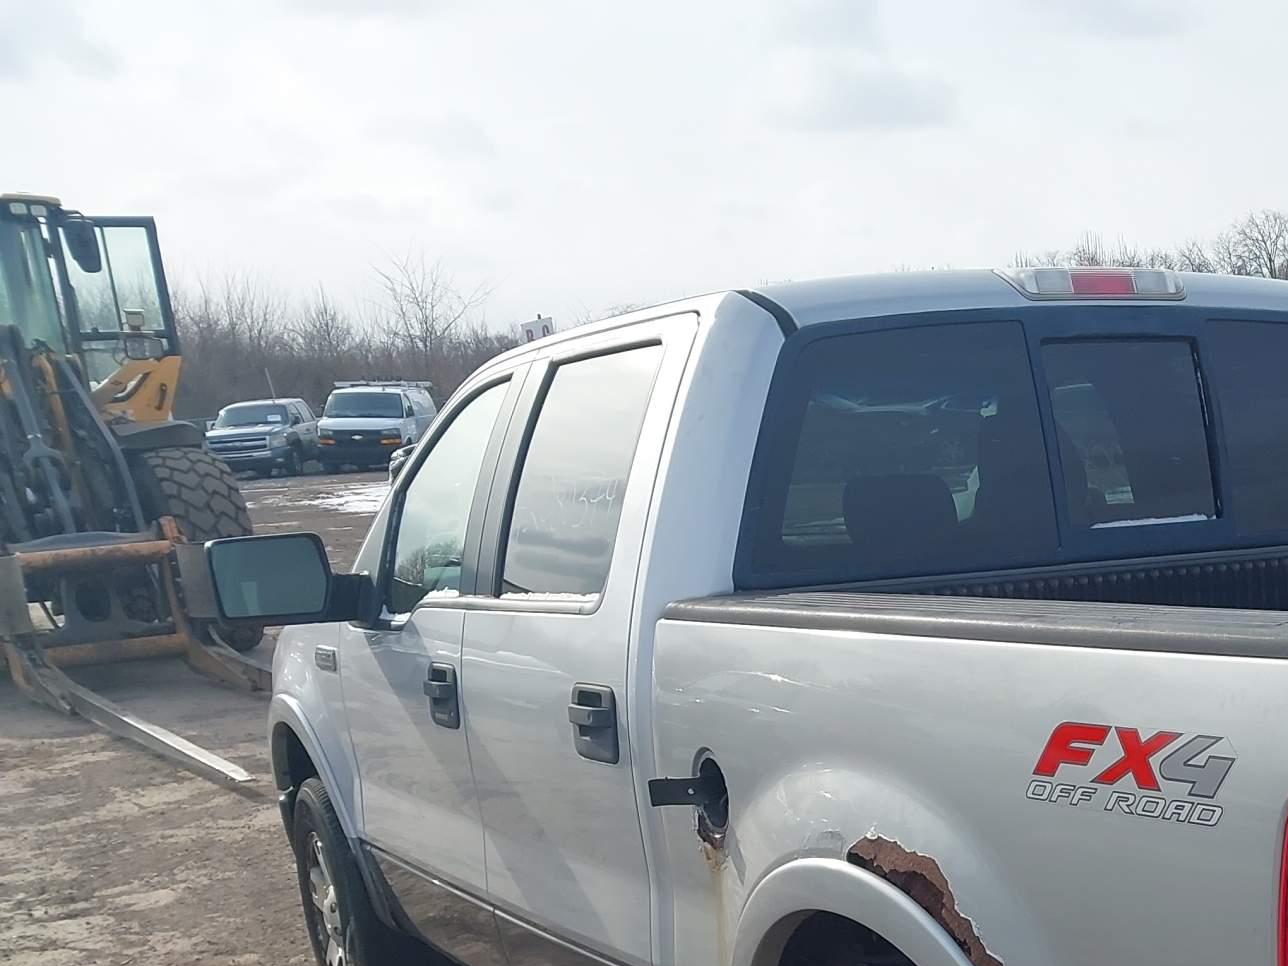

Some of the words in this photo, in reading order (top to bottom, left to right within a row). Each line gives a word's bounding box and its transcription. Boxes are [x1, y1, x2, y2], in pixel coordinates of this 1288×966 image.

[1032, 721, 1237, 799] FX4
[1025, 779, 1098, 806] OFF
[1103, 790, 1224, 827] ROAD
